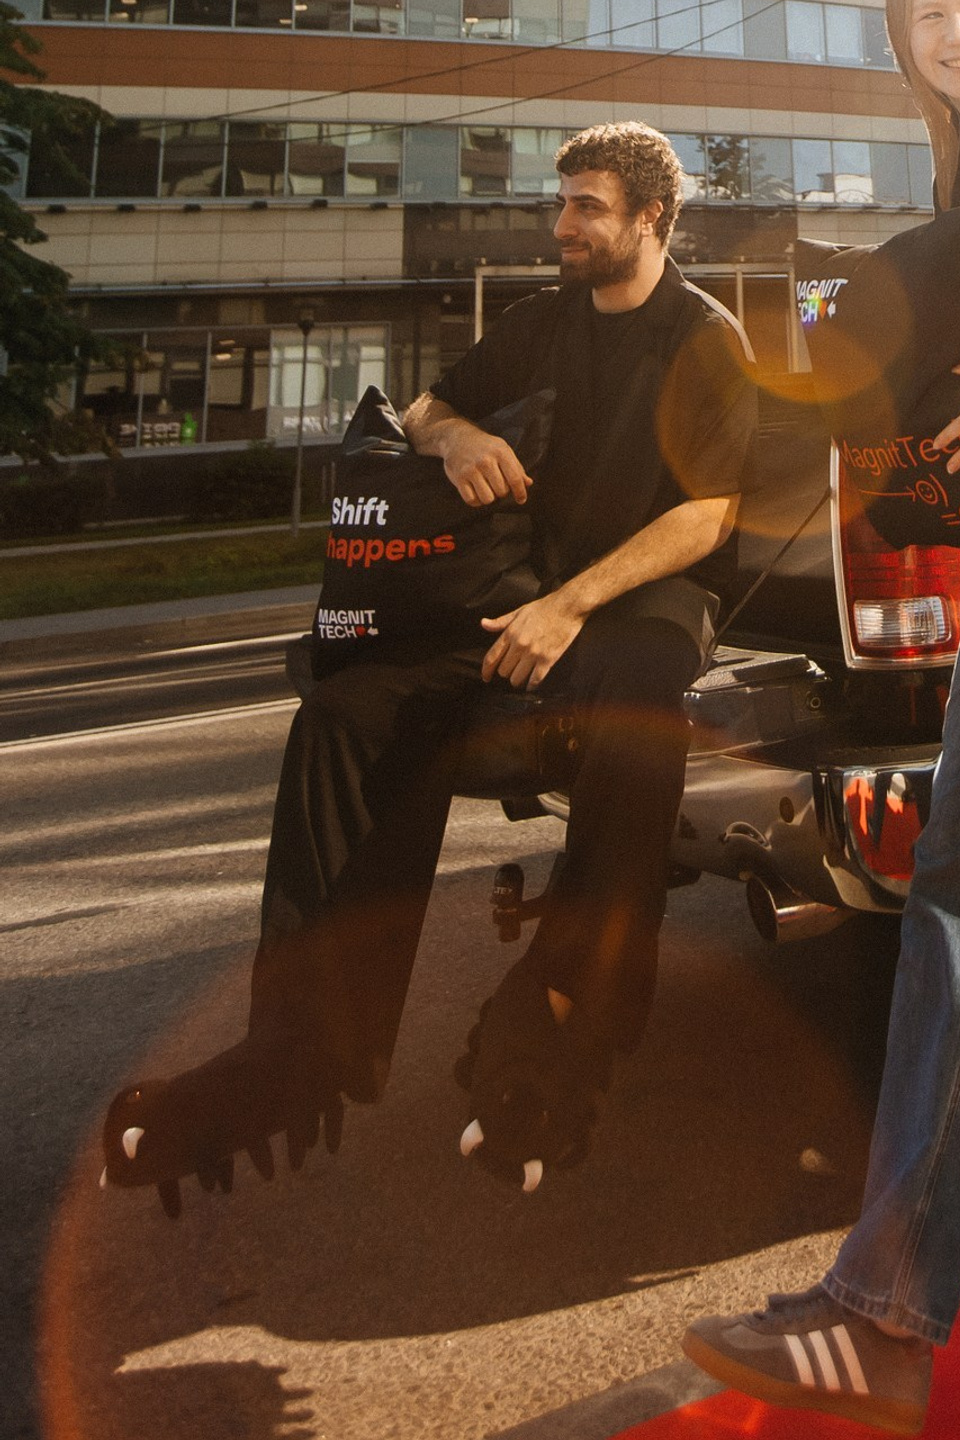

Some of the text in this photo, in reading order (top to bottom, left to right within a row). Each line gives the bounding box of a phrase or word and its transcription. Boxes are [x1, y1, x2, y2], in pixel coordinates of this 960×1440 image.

[331, 496, 389, 526] Shift
[326, 530, 456, 568] happens
[318, 608, 376, 625] MAGNIT
[318, 624, 357, 639] TECH
